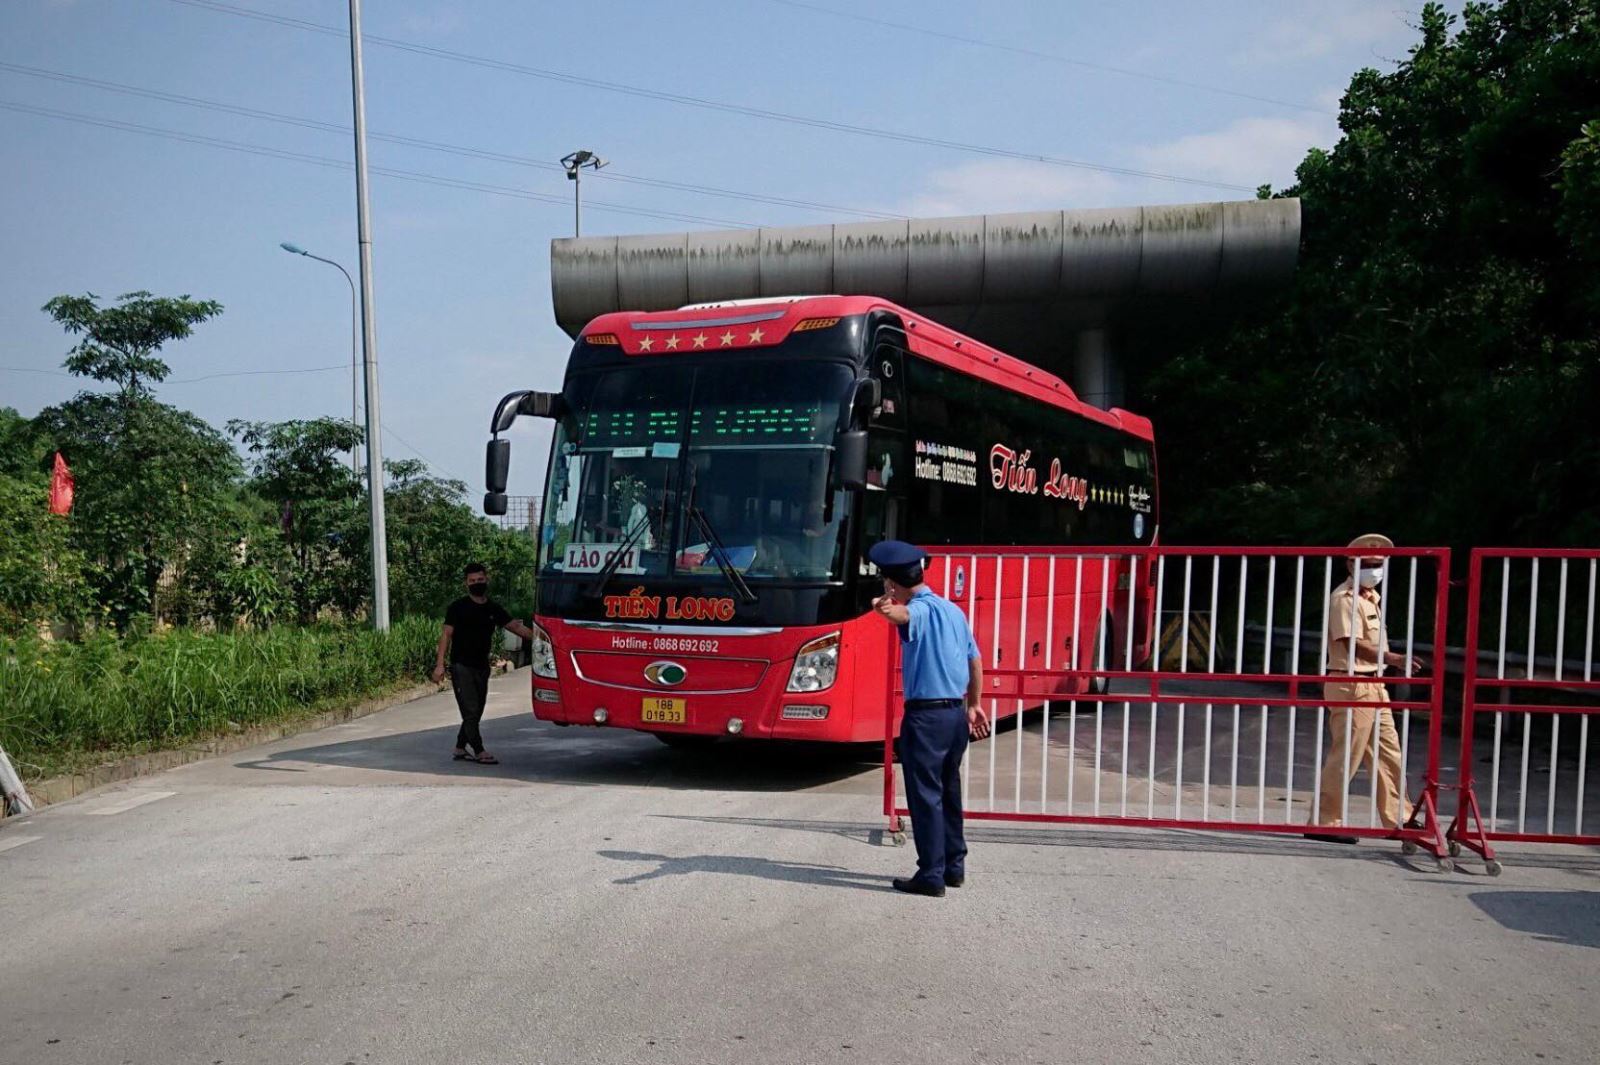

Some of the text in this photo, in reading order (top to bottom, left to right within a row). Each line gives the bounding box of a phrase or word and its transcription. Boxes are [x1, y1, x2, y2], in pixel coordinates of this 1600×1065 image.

[1044, 457, 1089, 511] Long
[568, 545, 600, 568] LÀO
[665, 596, 735, 621] LONG
[653, 638, 678, 651] 0868
[679, 639, 698, 652] 692
[699, 640, 719, 653] 692
